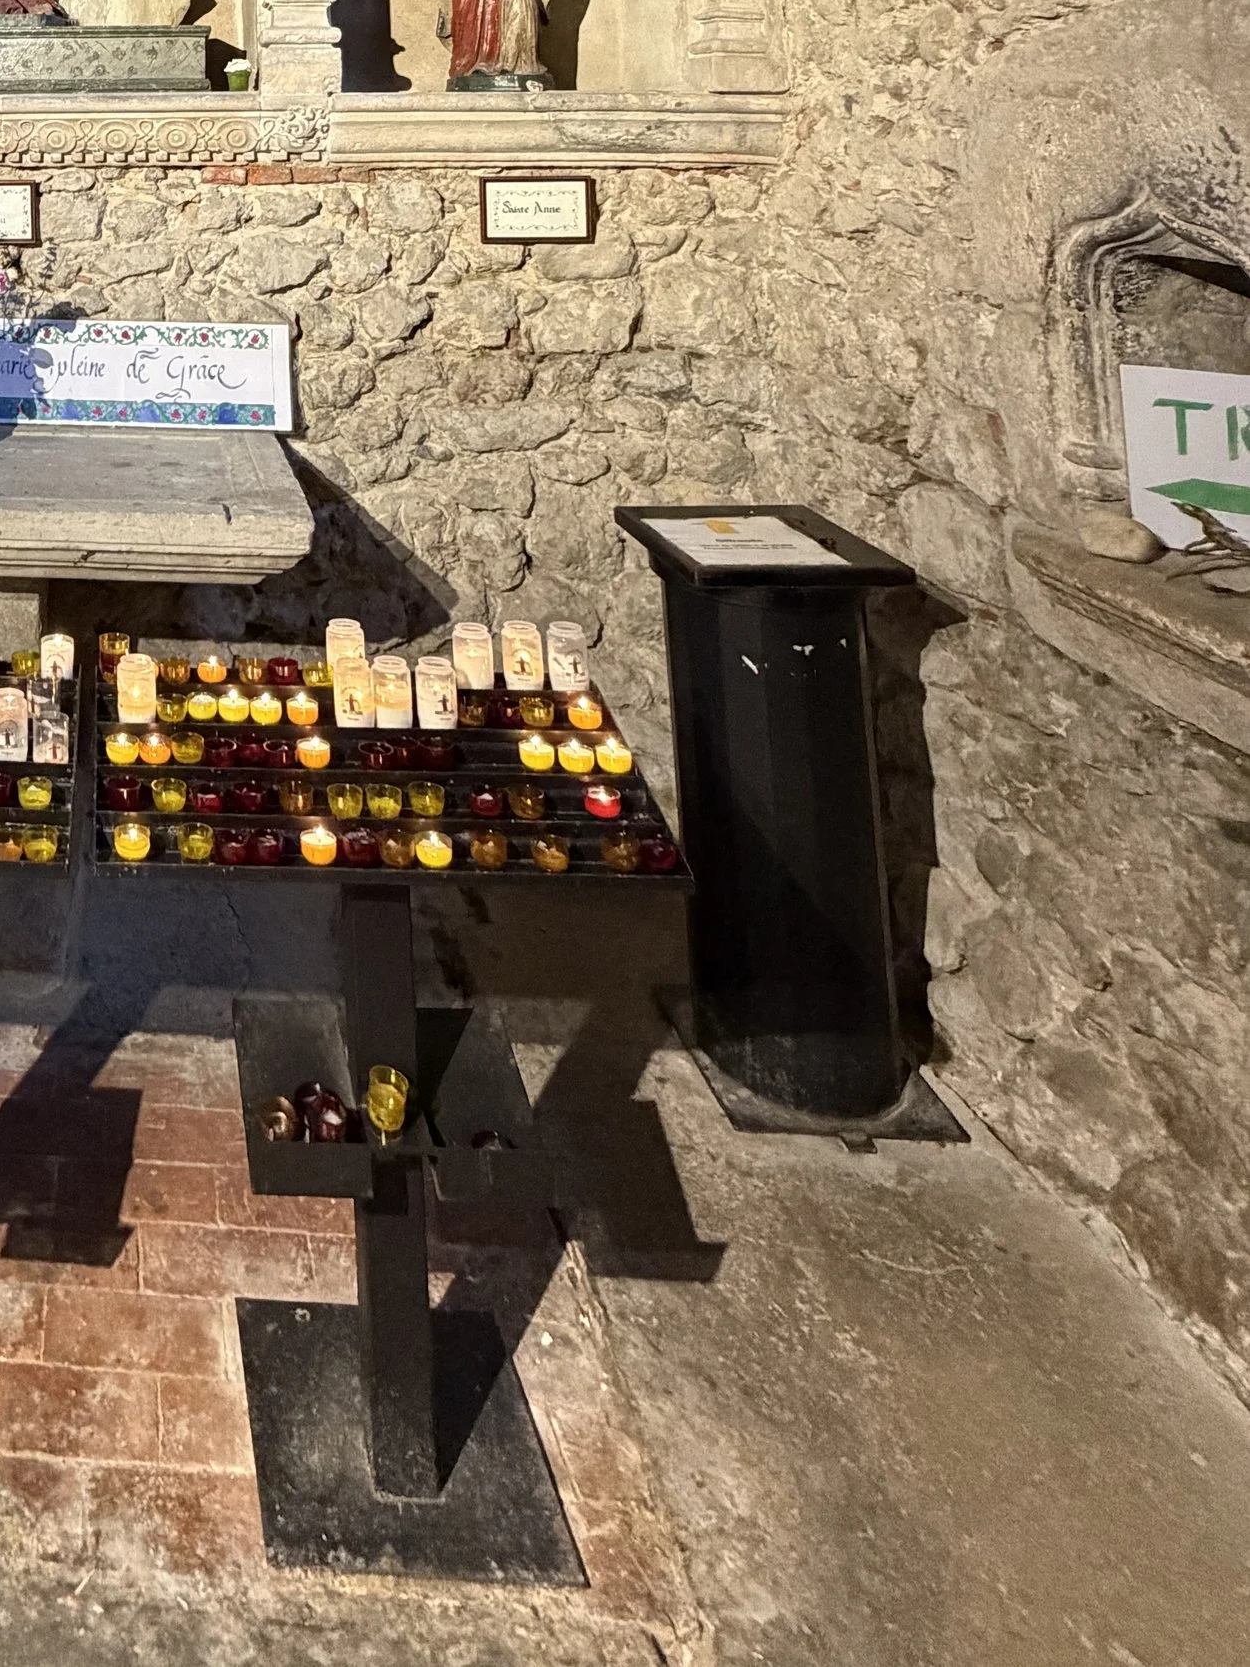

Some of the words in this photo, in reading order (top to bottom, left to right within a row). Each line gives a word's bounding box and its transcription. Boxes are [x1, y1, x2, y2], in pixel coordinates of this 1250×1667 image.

[502, 200, 530, 214] Sainte
[533, 201, 562, 216] Anne
[126, 347, 162, 384] de
